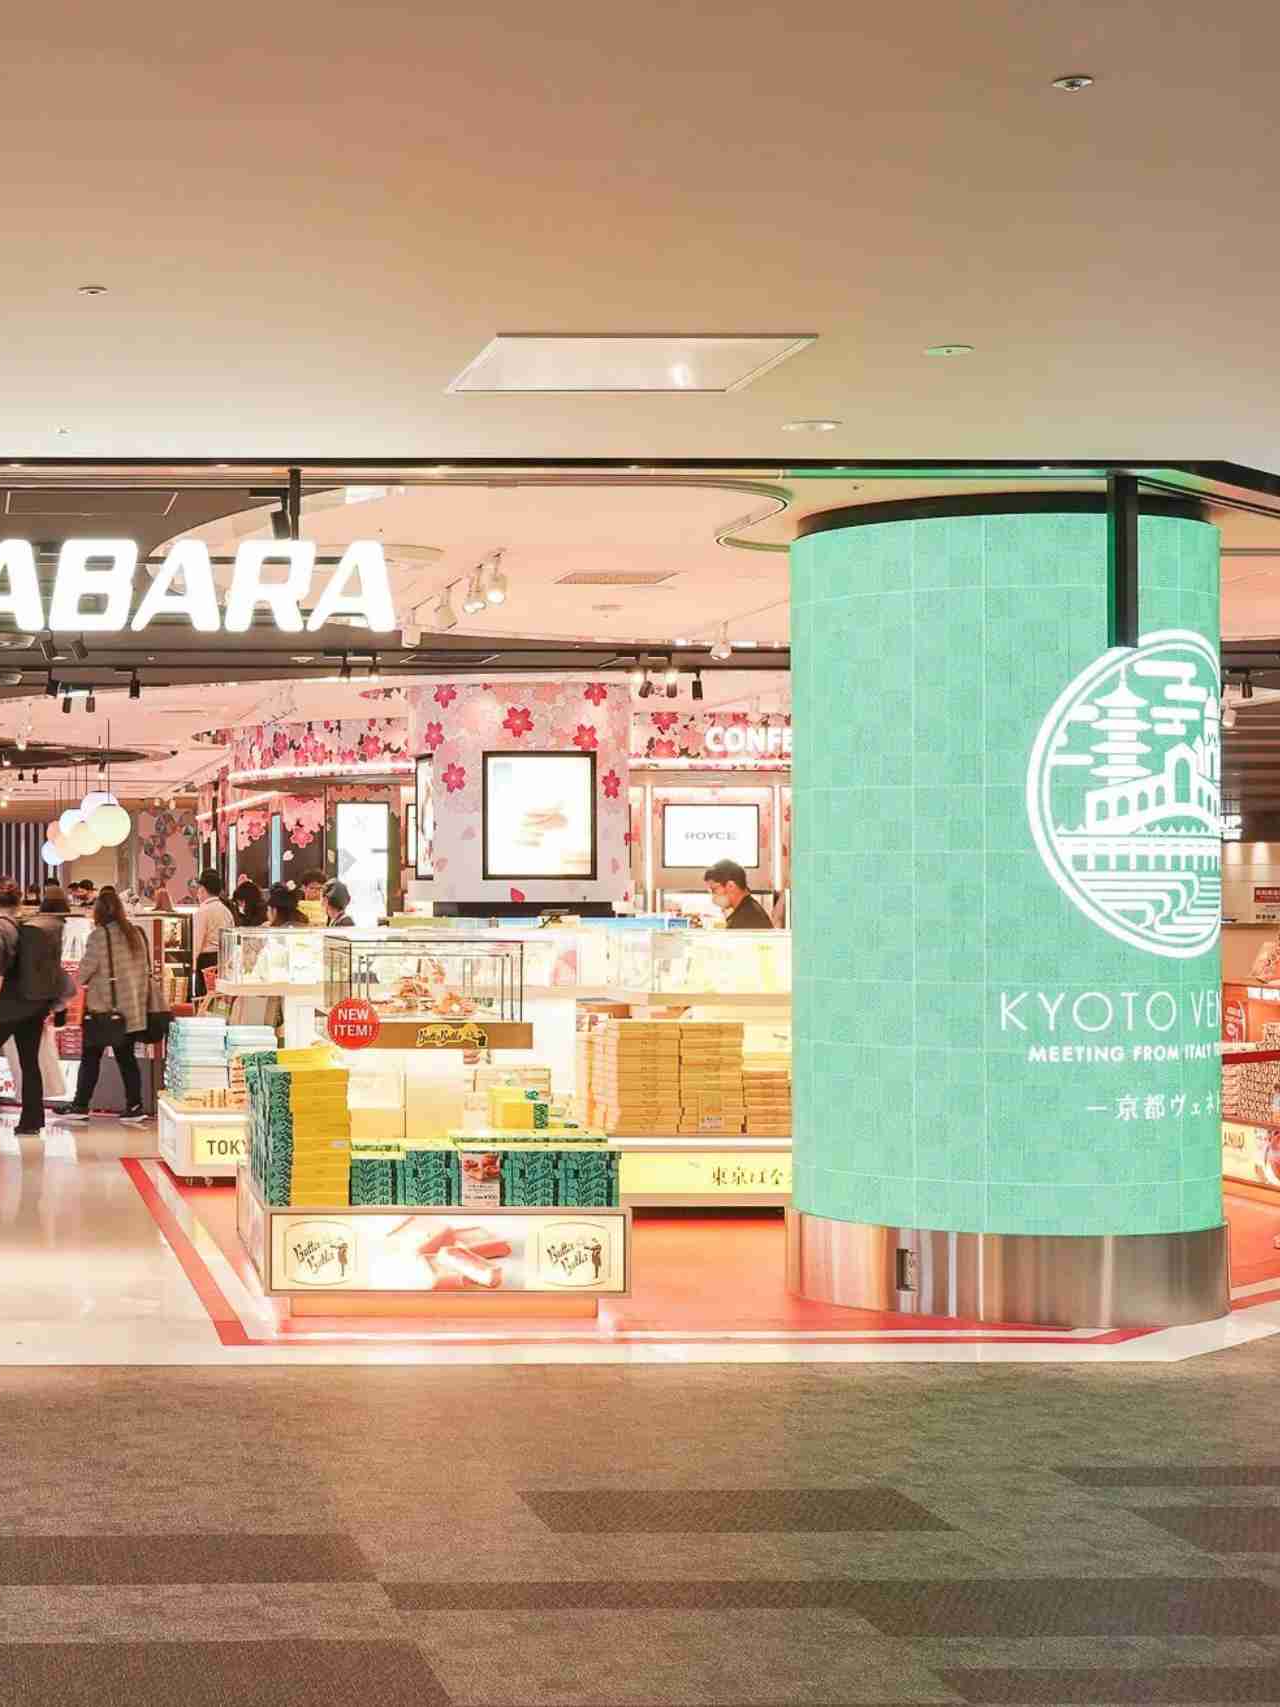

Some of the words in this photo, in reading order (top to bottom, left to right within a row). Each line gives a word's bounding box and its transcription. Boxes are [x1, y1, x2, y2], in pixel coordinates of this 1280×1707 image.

[336, 1007, 371, 1021] NEW
[1000, 991, 1177, 1032] KYOTO
[333, 1023, 373, 1037] ITEM!
[1027, 1044, 1125, 1063] MEETING
[1132, 1044, 1180, 1062] FROM
[1183, 1042, 1212, 1060] ITALY
